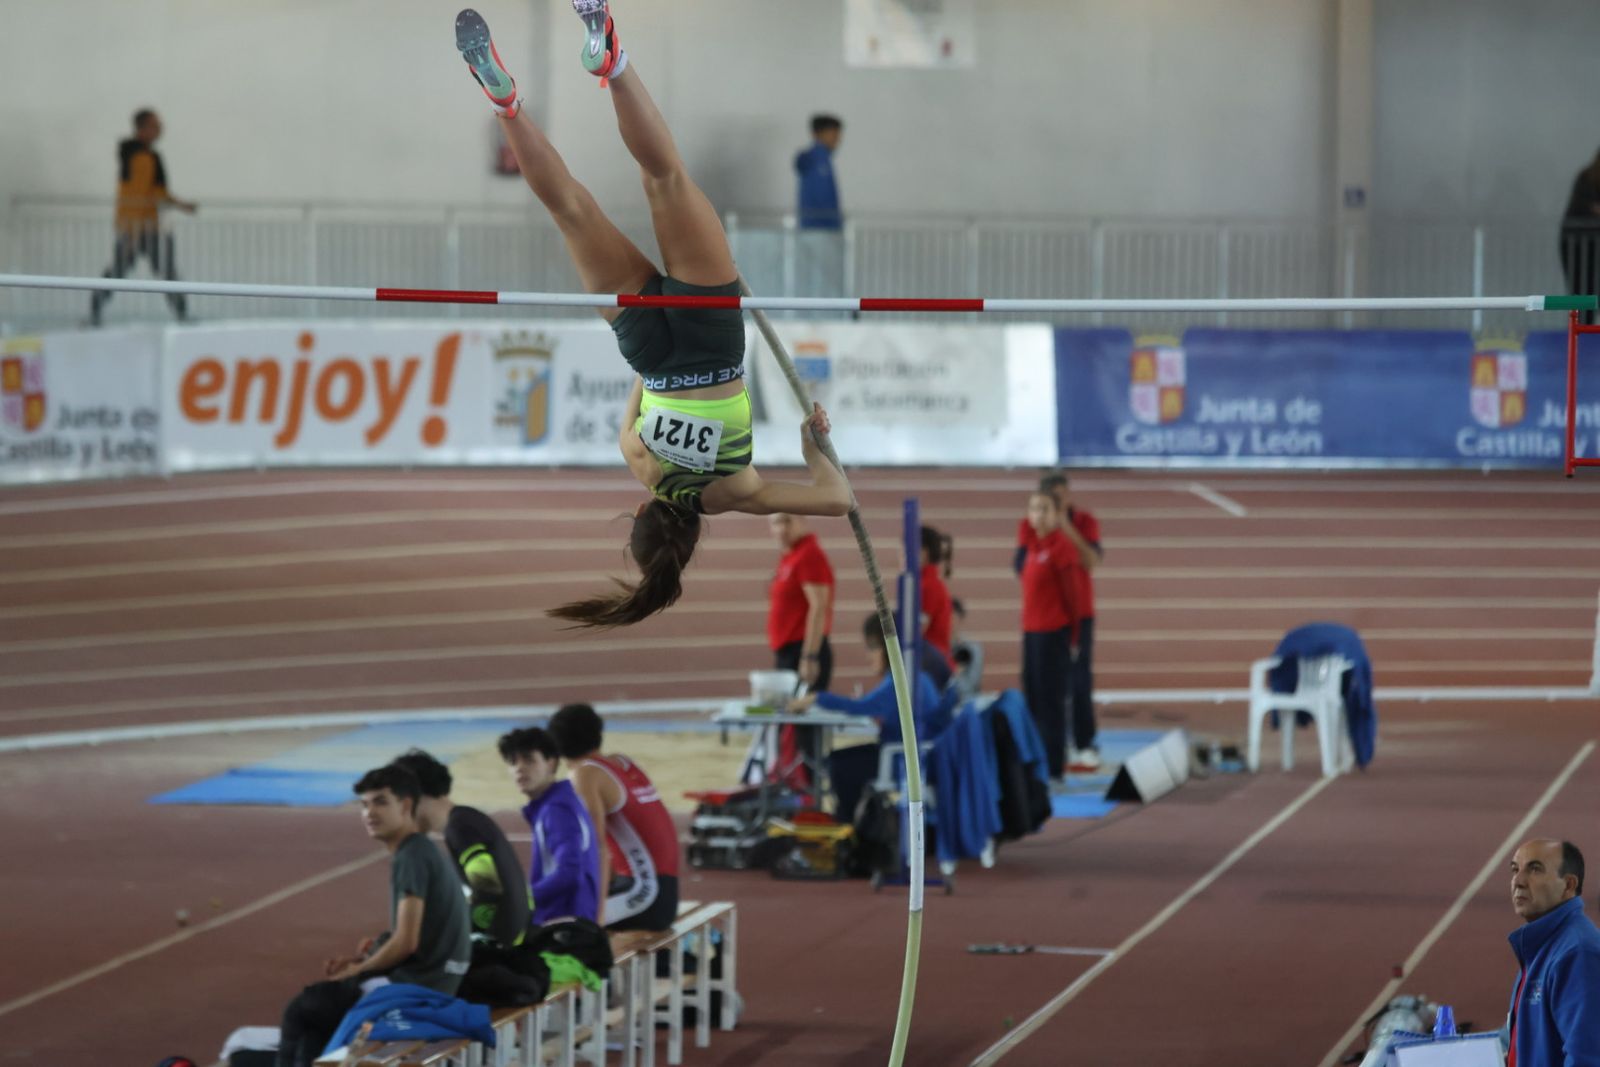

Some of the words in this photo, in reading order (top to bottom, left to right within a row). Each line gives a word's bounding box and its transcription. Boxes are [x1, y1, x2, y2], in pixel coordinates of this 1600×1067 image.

[178, 331, 463, 449] enjoy!
[1196, 394, 1277, 424] Junta
[1284, 393, 1323, 424] de
[653, 415, 714, 453] 3121
[1115, 423, 1218, 455] Castilla
[1224, 429, 1245, 461] y
[1250, 424, 1323, 454] León
[1456, 425, 1561, 457] Castilla
